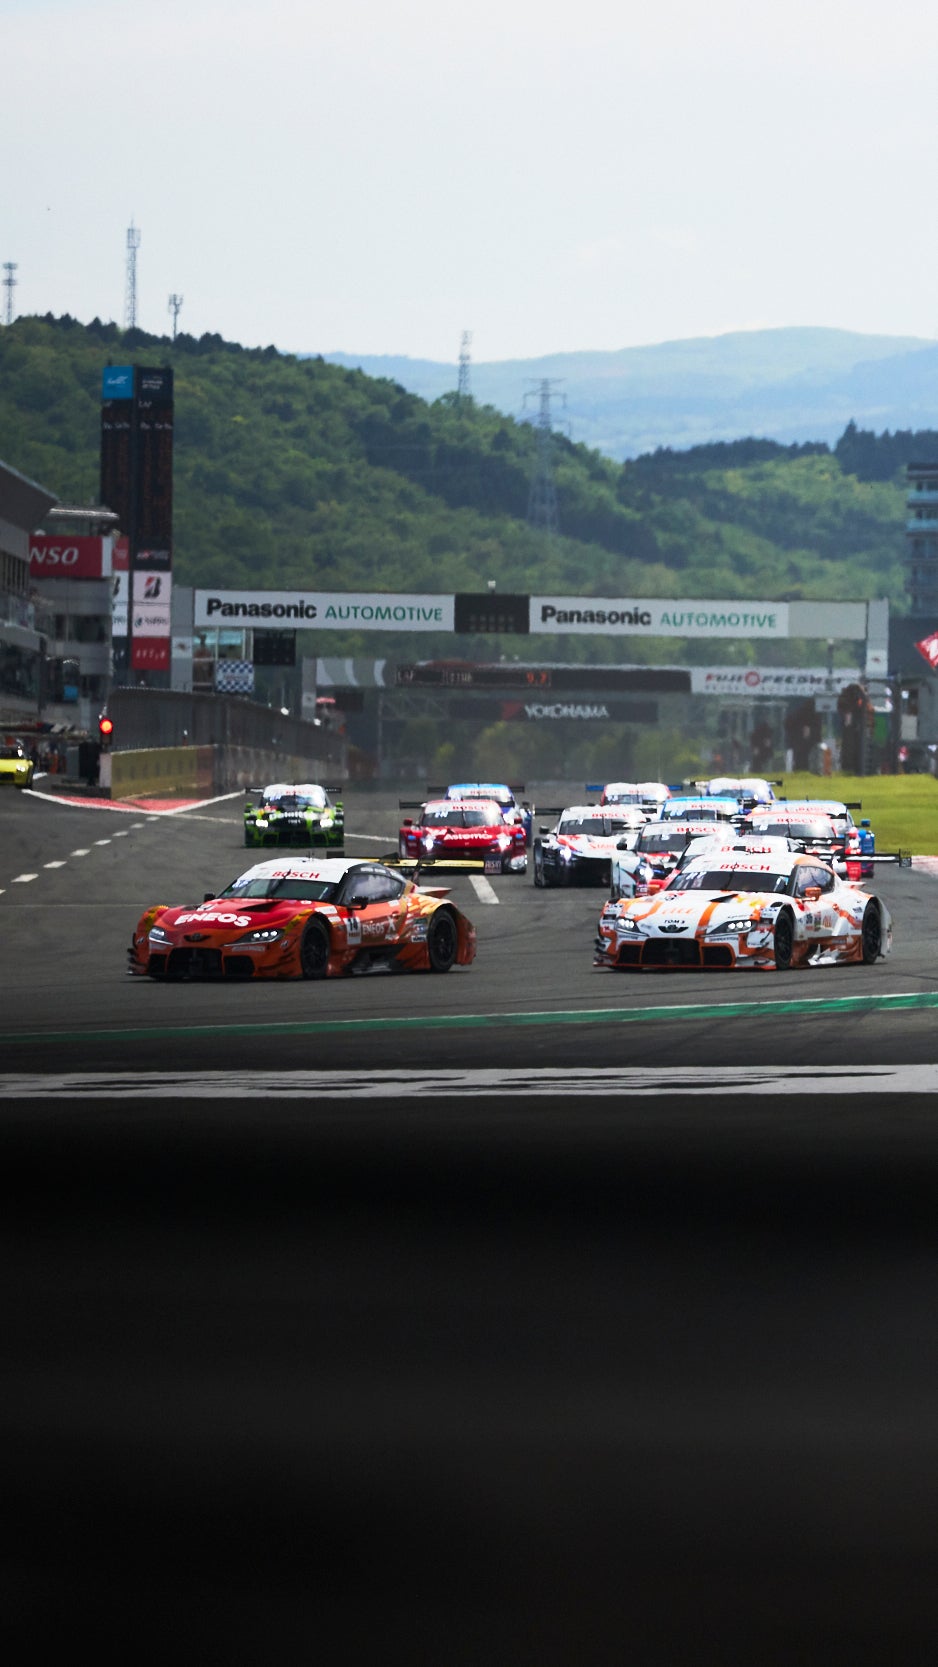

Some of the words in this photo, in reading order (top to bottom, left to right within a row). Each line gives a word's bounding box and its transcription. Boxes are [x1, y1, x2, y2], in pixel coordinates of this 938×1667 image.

[206, 598, 317, 619] Panasonic
[325, 605, 443, 621] AUTOMOTIVE
[541, 605, 652, 626] Panasonic
[660, 612, 777, 628] AUTOMOTIVE
[524, 704, 610, 719] YOKOHAMA
[720, 846, 772, 854] BSCH
[720, 863, 771, 872] BOSCH
[272, 871, 321, 879] BOSCH
[174, 912, 252, 927] ENEOS
[362, 923, 385, 935] ENEOS
